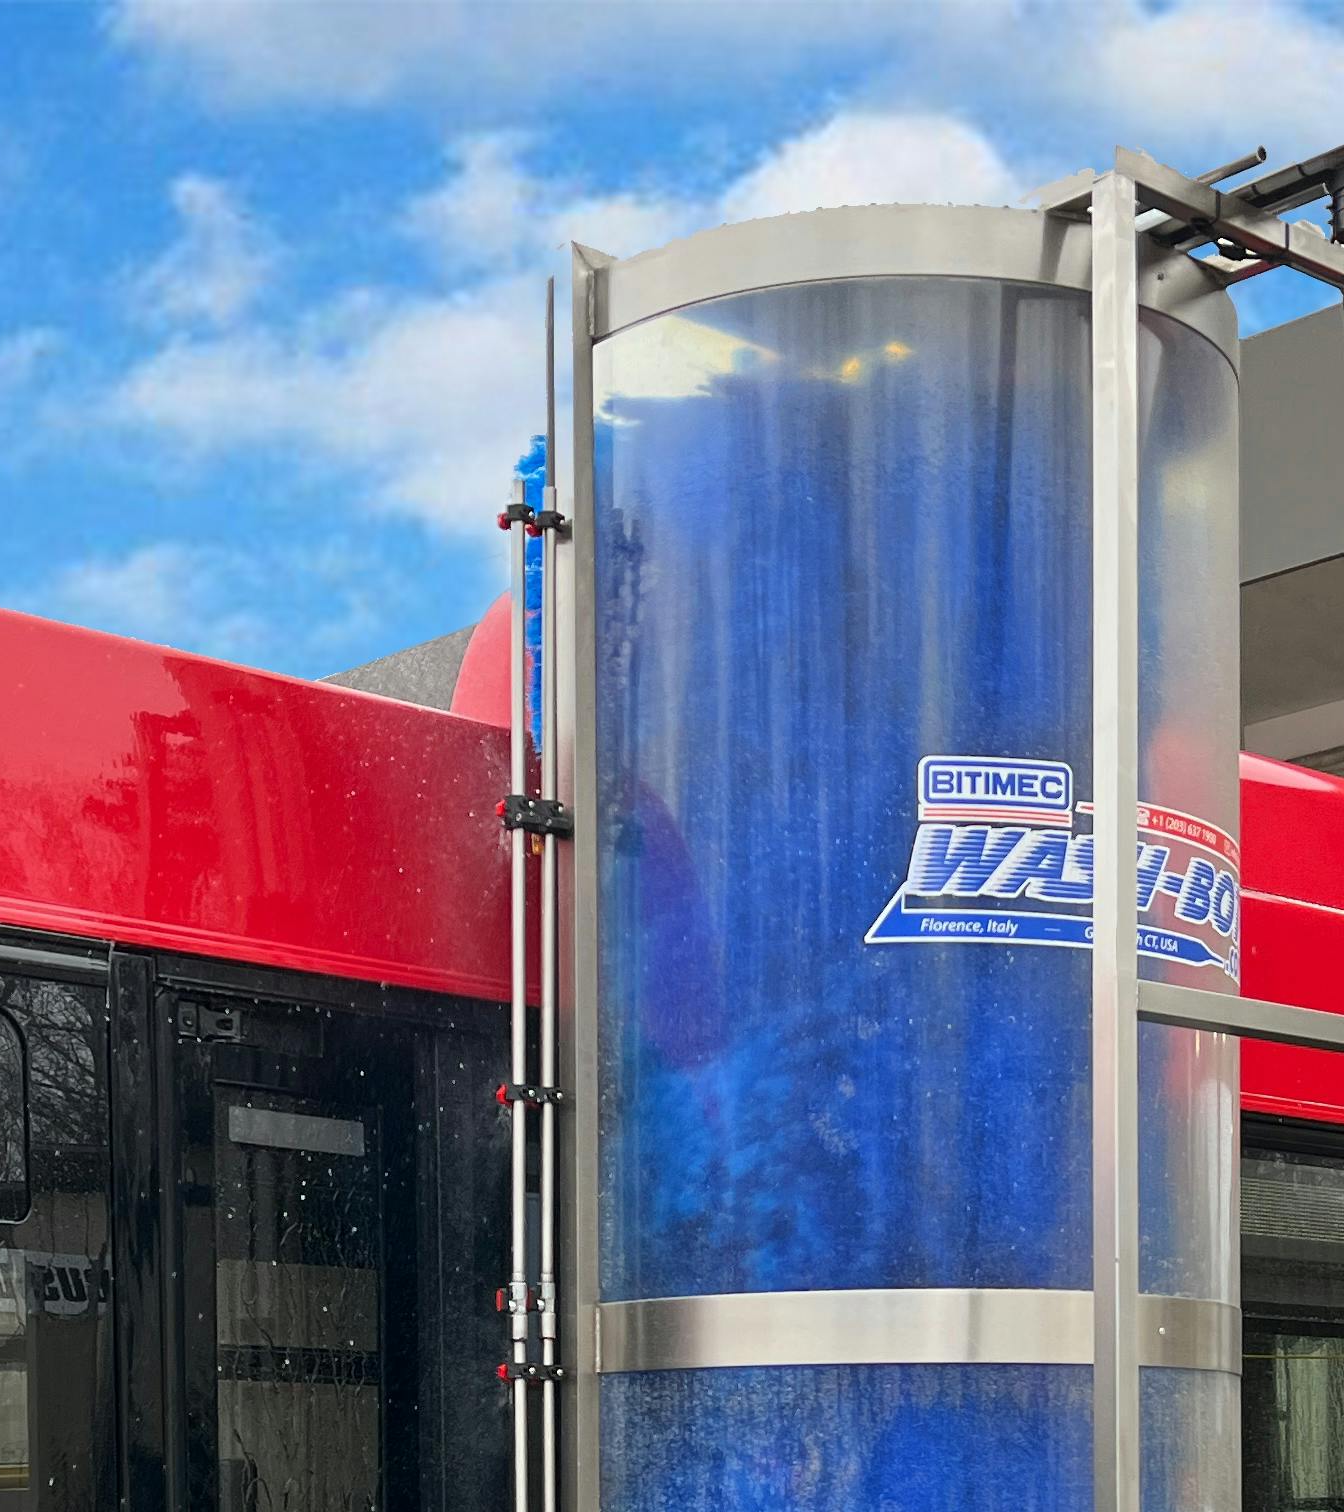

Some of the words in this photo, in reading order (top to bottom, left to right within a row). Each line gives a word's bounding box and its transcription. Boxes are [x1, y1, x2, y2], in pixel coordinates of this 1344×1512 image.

[931, 769, 1064, 800] BITIMEC
[920, 917, 984, 934] Florence,
[987, 918, 1018, 935] Italy
[1160, 938, 1179, 953] USA
